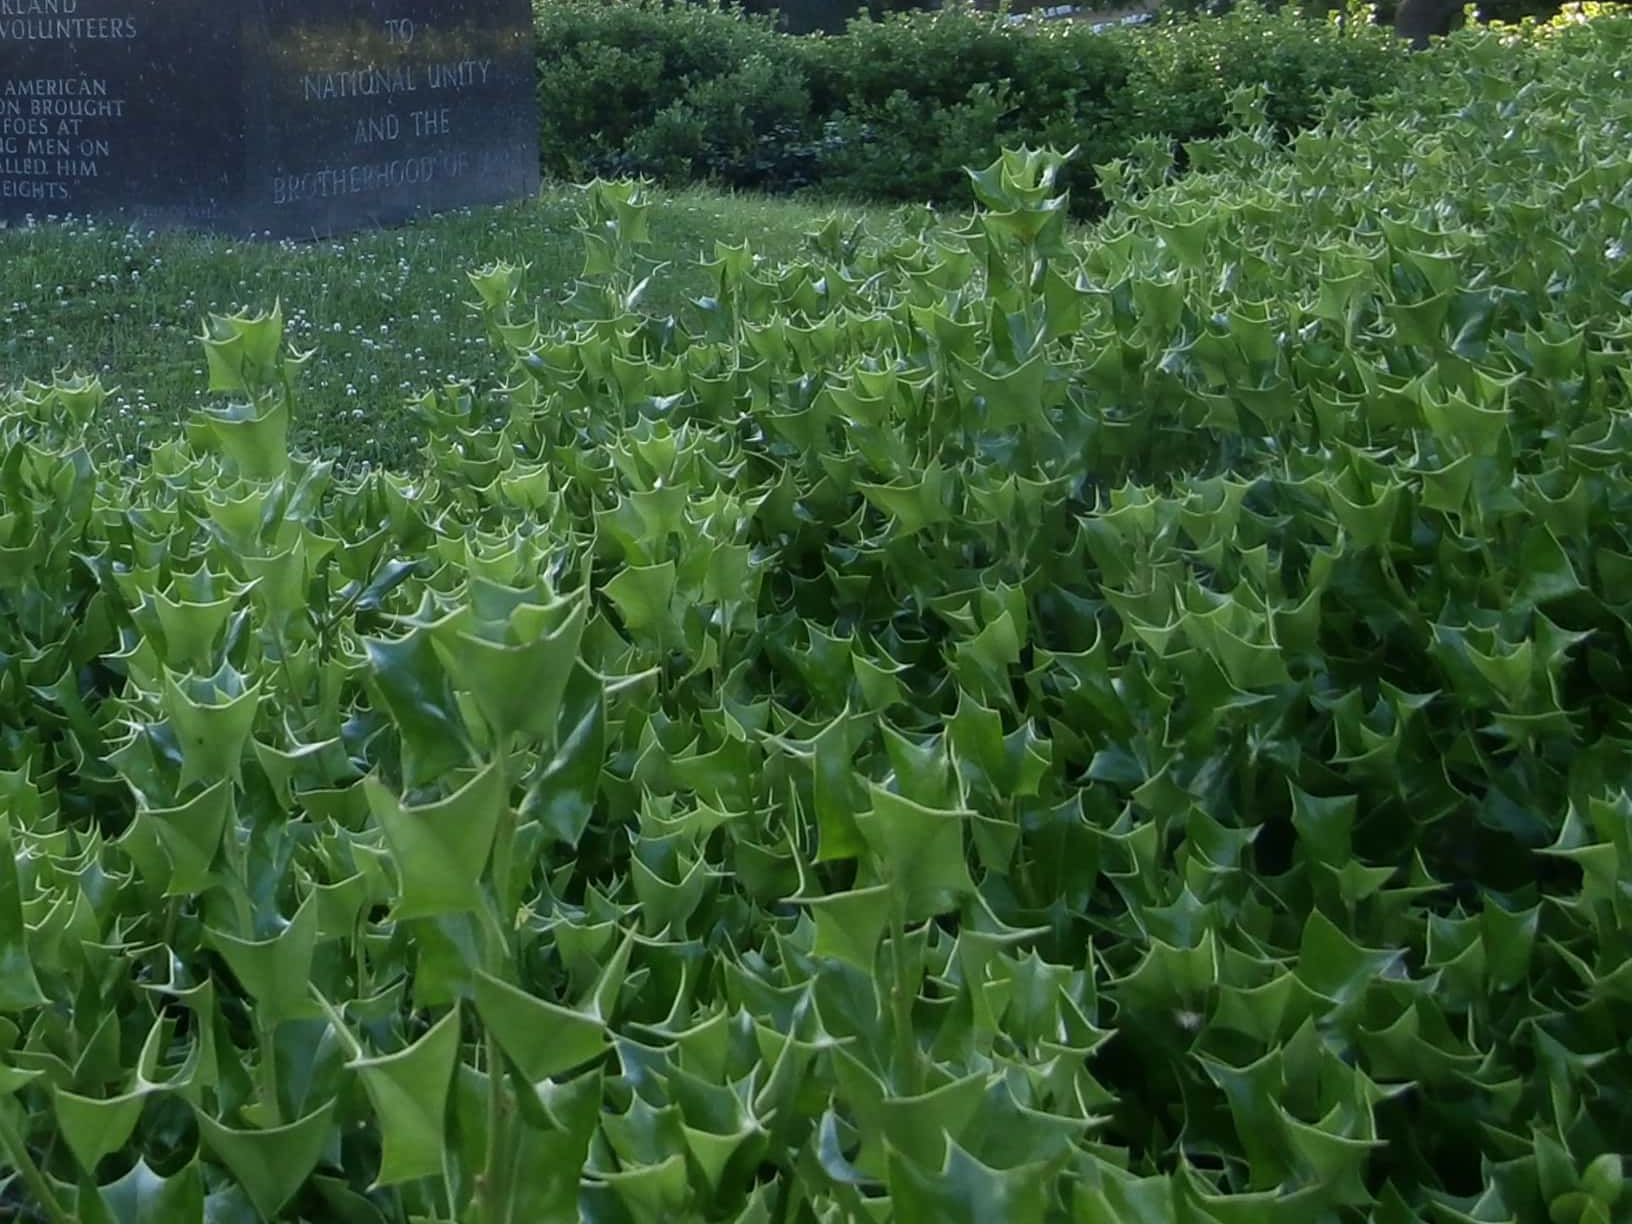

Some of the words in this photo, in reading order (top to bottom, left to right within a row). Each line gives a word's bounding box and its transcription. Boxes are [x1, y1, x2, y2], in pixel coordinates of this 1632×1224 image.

[385, 18, 414, 45] TO
[5, 79, 107, 96] AMERICAN
[303, 65, 416, 101] NATIONAL
[428, 59, 490, 90] UNITY
[31, 98, 125, 117] BROUGHT
[3, 118, 48, 135] FOES
[57, 119, 82, 136] AT
[354, 113, 400, 145] AND
[410, 108, 450, 136] THE
[27, 137, 70, 155] MEN
[80, 139, 110, 157] ON
[57, 160, 97, 177] HIM
[272, 155, 433, 204] BROTHERHOOD
[443, 152, 469, 178] OF
